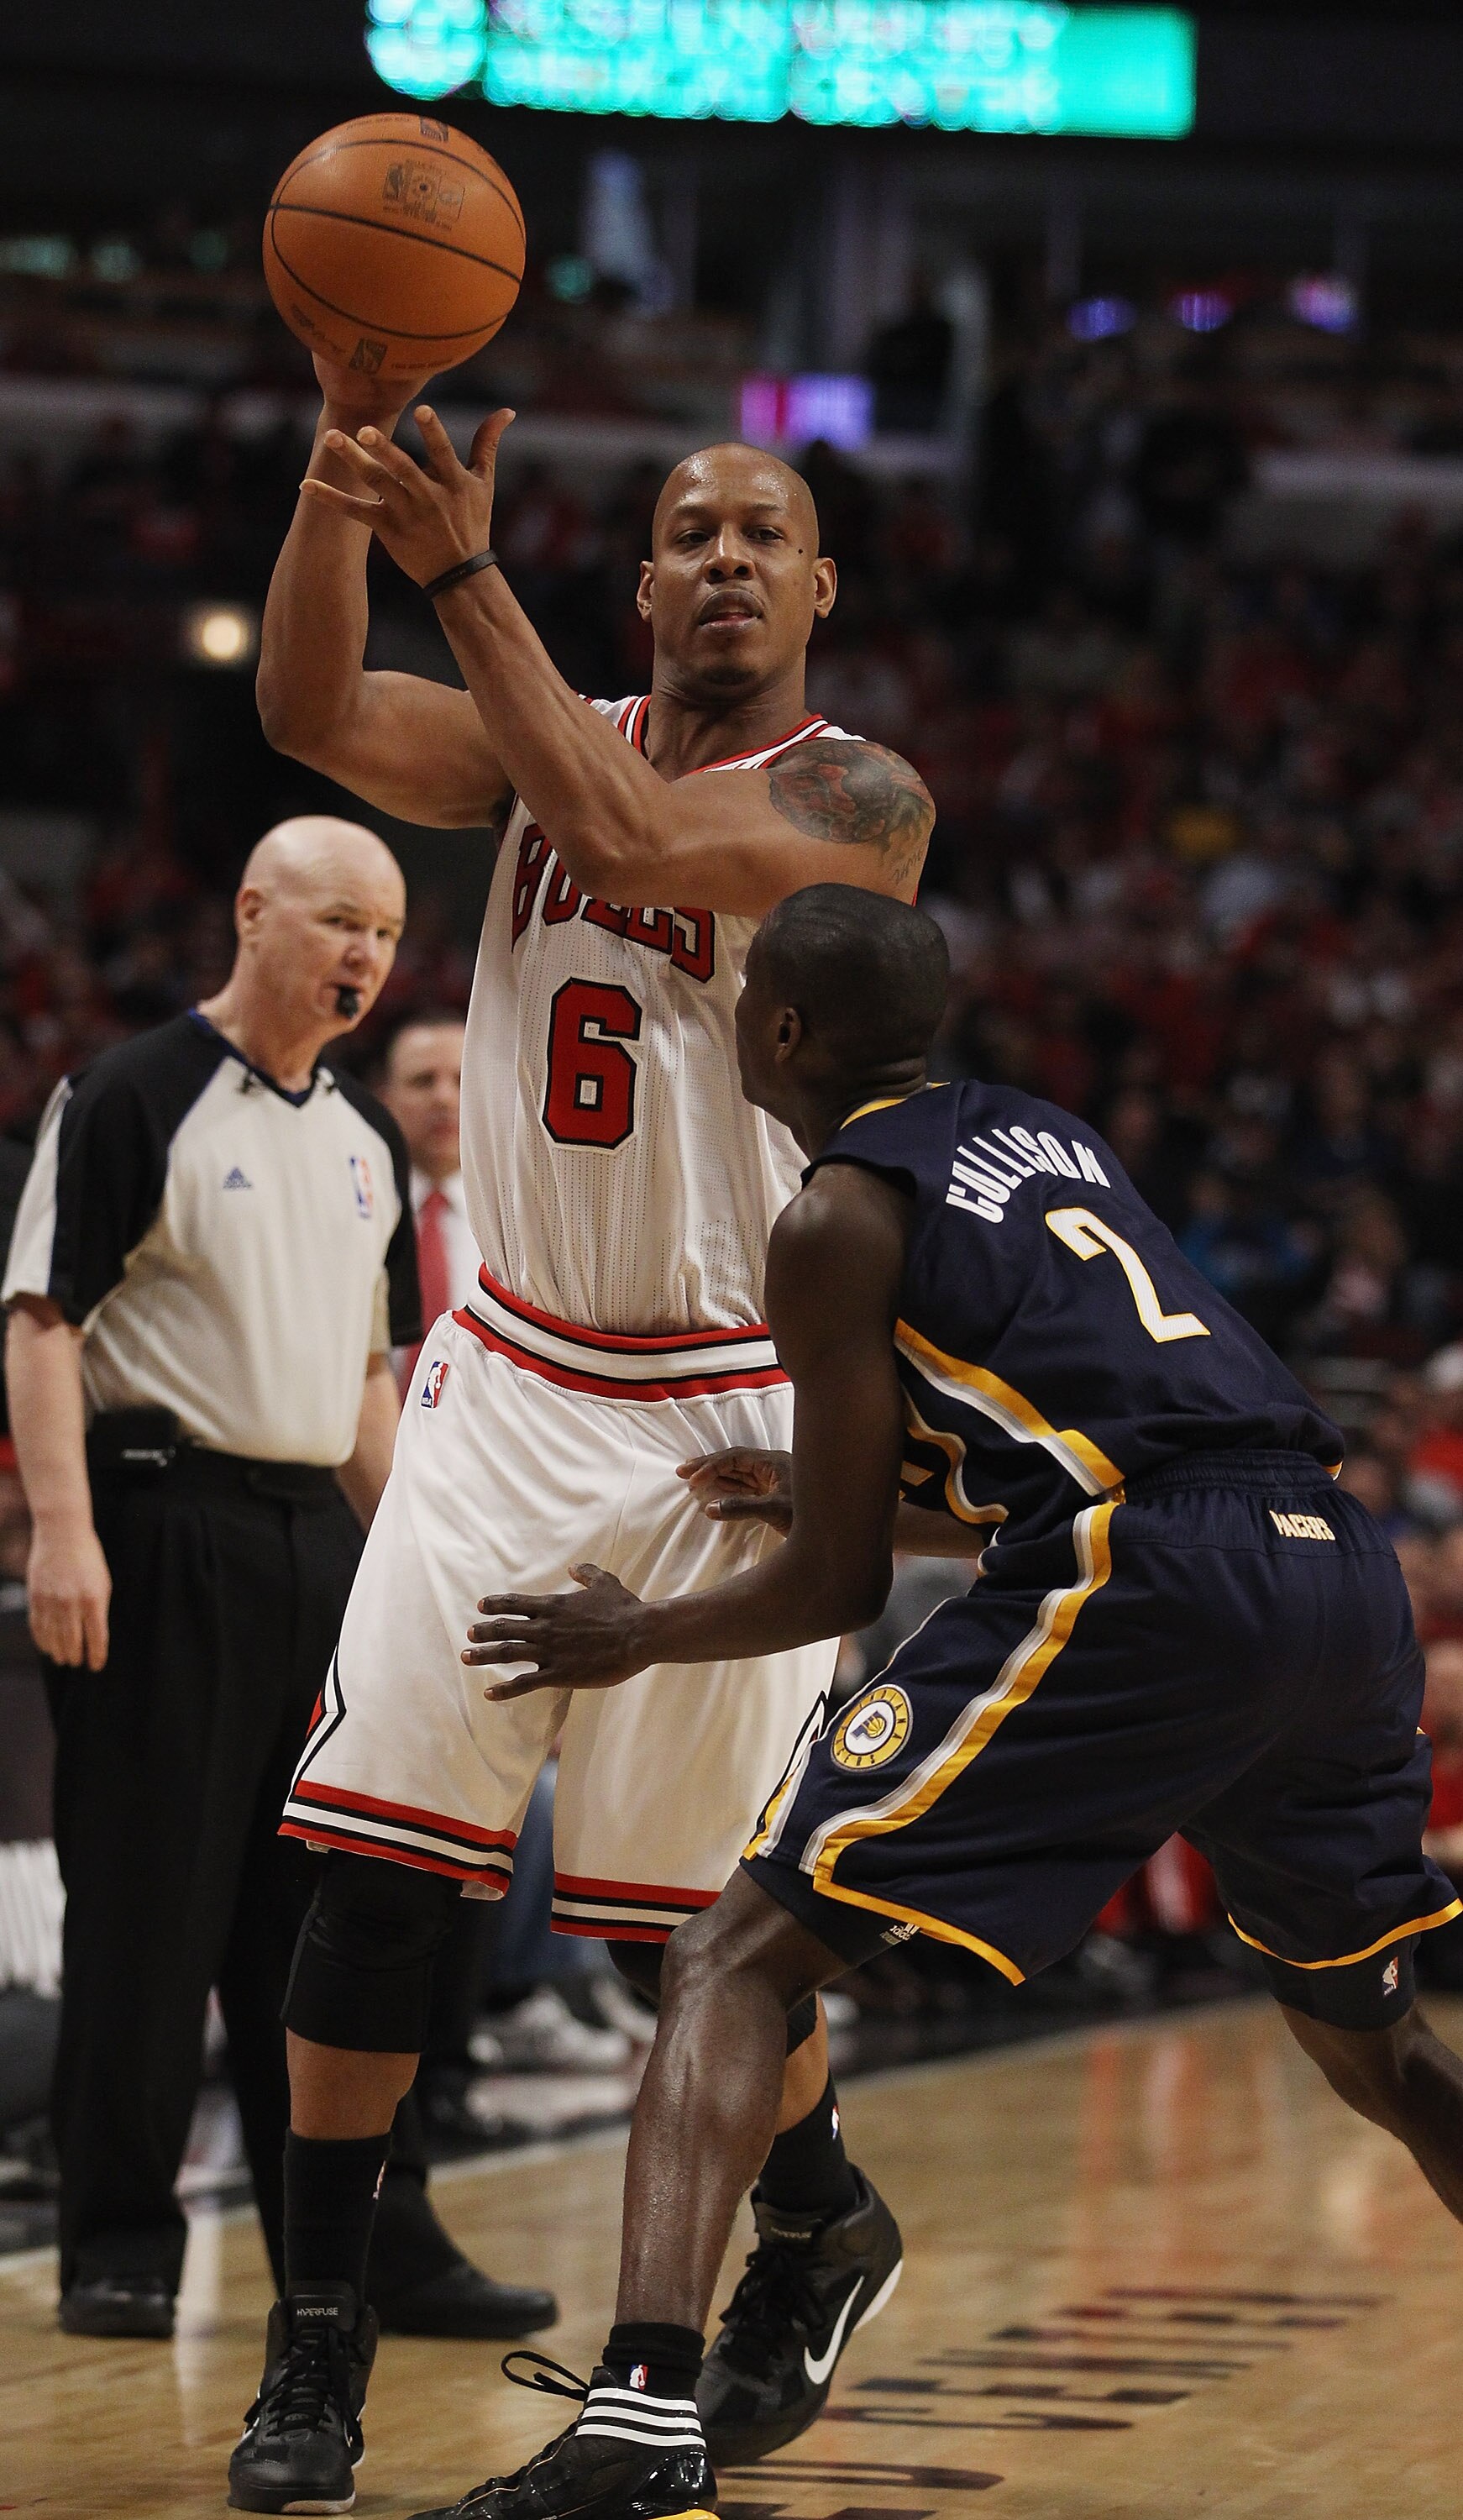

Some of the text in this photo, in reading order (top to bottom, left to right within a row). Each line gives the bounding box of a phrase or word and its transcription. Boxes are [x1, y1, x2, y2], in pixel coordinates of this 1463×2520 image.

[542, 976, 643, 1151] 6
[946, 1126, 1111, 1223] COLLISON
[1045, 1207, 1211, 1343] 2
[296, 2307, 338, 2317] HYPERFUSE
